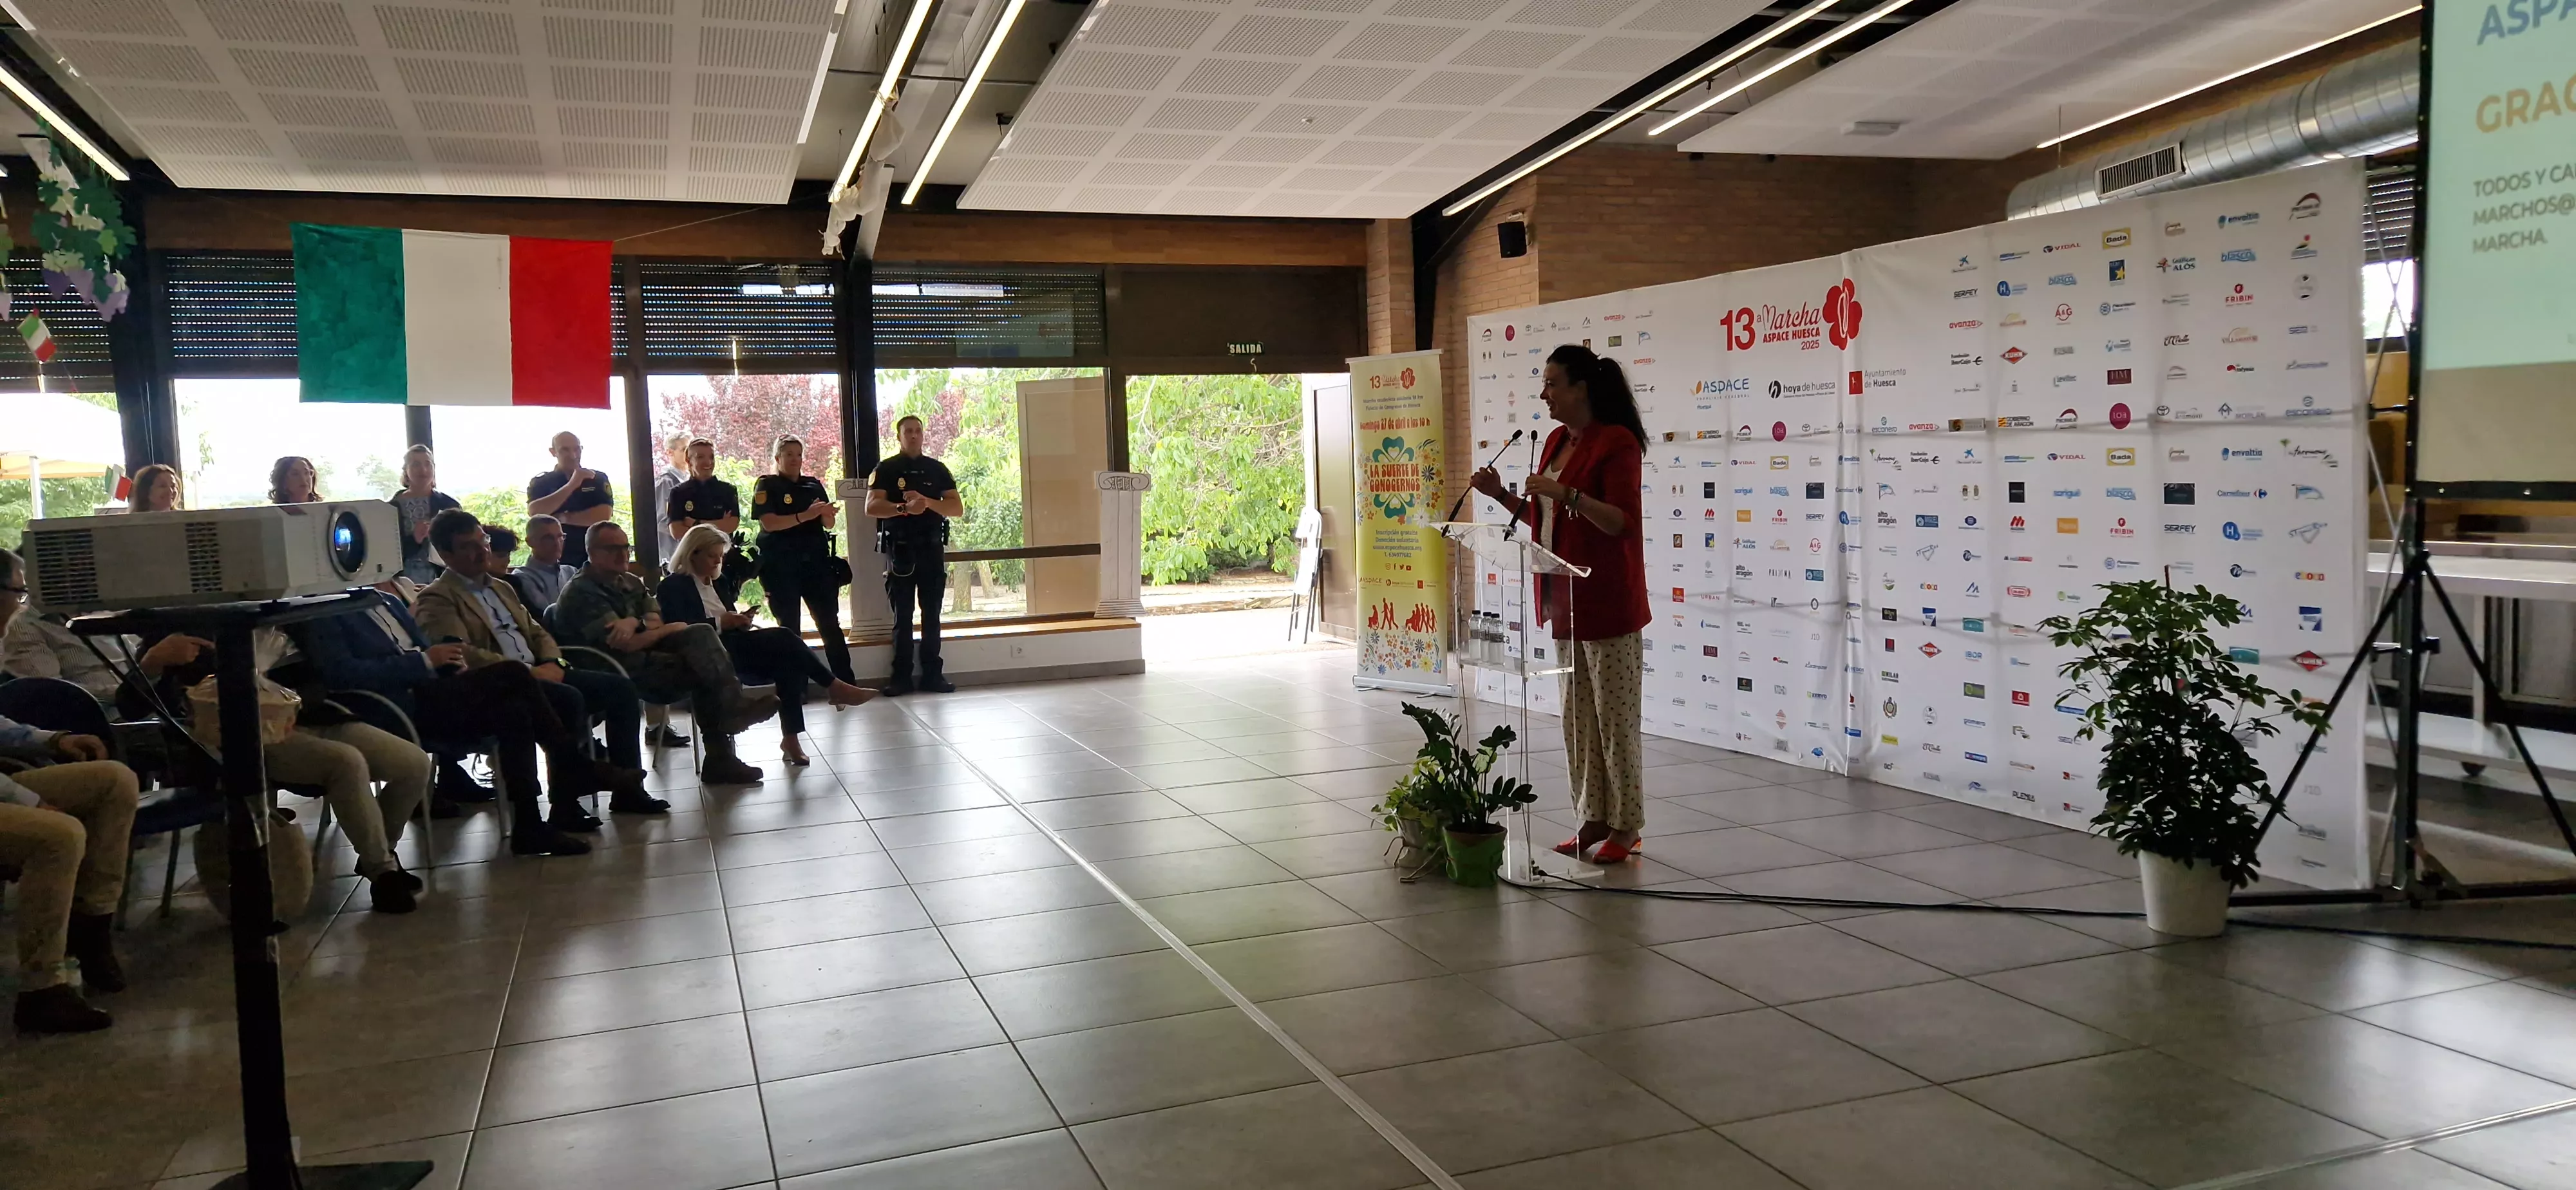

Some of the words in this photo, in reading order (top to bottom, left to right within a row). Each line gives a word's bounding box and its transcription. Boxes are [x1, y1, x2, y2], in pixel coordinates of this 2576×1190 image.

[2474, 170, 2531, 197] TODOS
[2535, 167, 2547, 185] Y
[2550, 162, 2576, 184] CA
[1953, 288, 1978, 298] SERFEY
[1762, 301, 1822, 331] Marcha
[2055, 308, 2072, 317] A&G
[1949, 320, 1976, 328] avanza
[1763, 331, 1790, 344] ASPACE
[1792, 327, 1821, 339] HUESCA
[1229, 344, 1262, 354] SALIDA
[1801, 339, 1820, 350] 2025
[1864, 368, 1906, 379] Ayuntamiento
[1369, 375, 1381, 389] 13
[1703, 378, 1750, 395] ASPACE
[1873, 379, 1896, 388] Huesca
[1381, 418, 1387, 430] 27
[1388, 417, 1394, 430] de
[1396, 417, 1405, 430] abril
[1426, 417, 1430, 426] h
[1370, 464, 1379, 478] LA
[1381, 464, 1409, 478] SUERTE
[1411, 463, 1419, 477] DE
[1370, 478, 1420, 493] CONOCERNOS
[1965, 650, 1982, 659] IBOR
